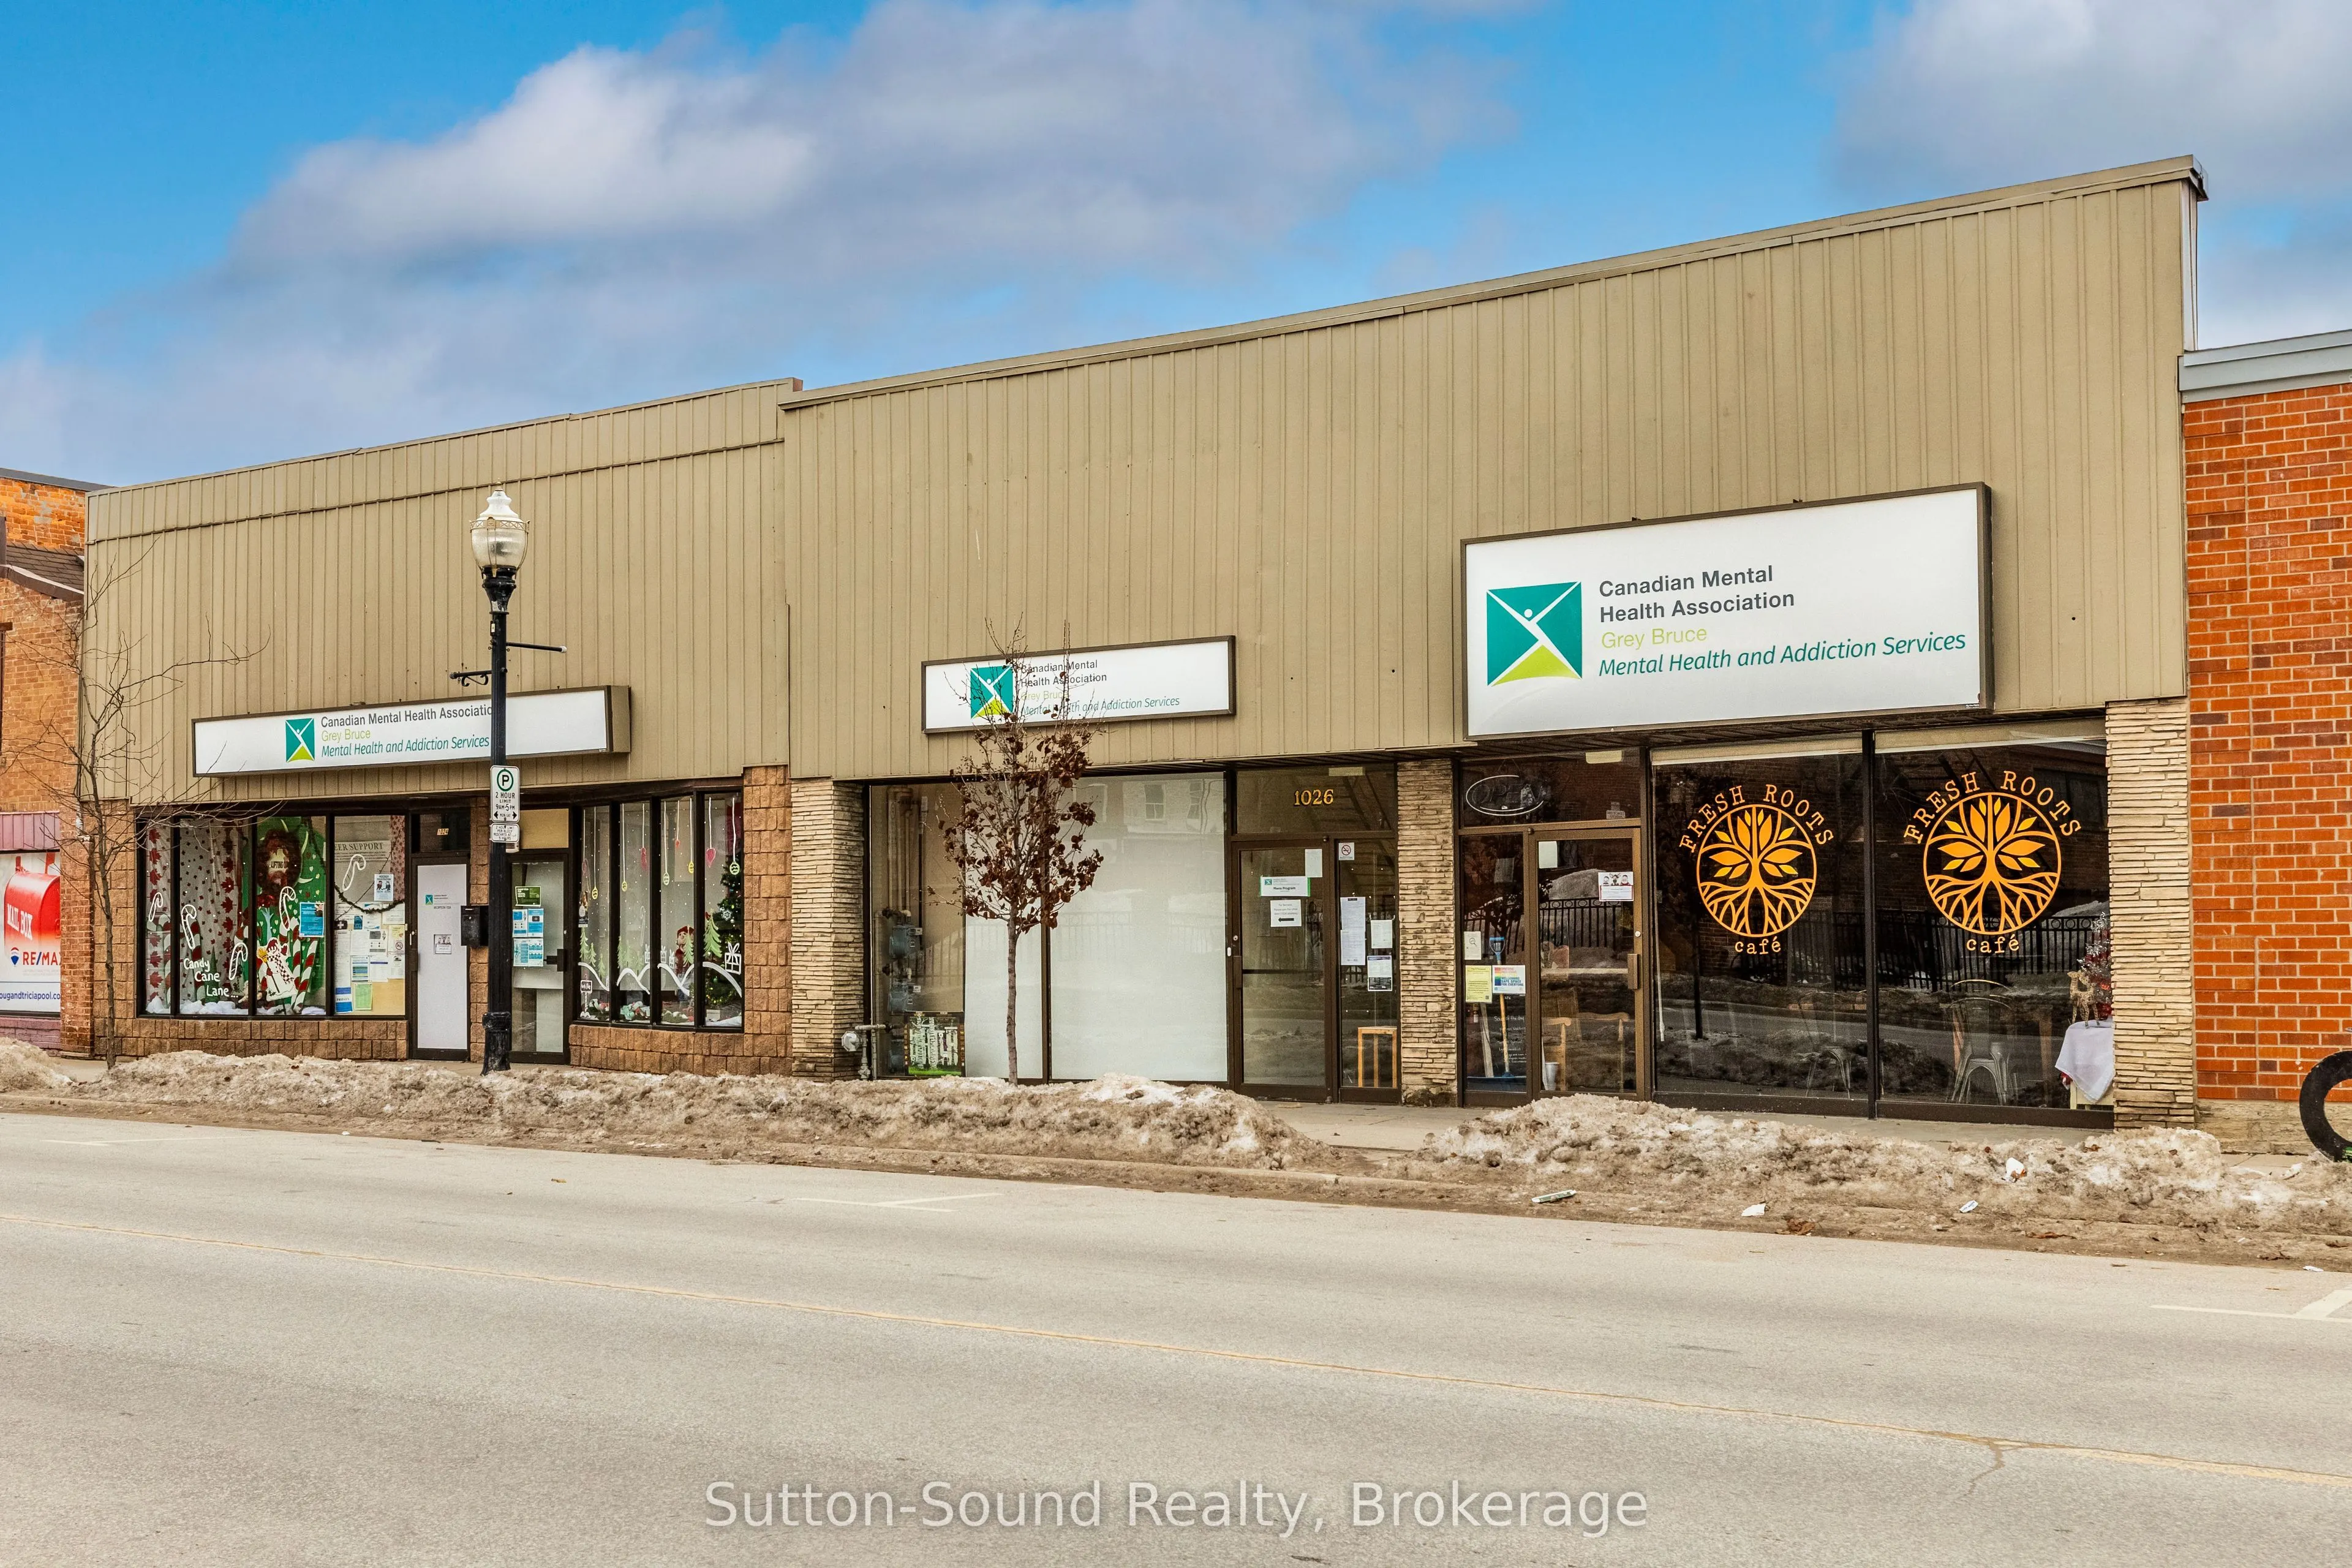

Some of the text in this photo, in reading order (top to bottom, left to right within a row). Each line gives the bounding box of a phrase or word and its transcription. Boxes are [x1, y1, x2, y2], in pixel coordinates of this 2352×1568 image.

[1599, 565, 1773, 597] Canadian Mental
[1600, 591, 1795, 622] Health Association
[1601, 627, 1707, 650] Grey Bruce
[1599, 631, 1966, 677] Mental Health and Addiction Services
[1067, 660, 1098, 671] Mental
[1021, 676, 1050, 687] Health
[1021, 690, 1068, 702] Grey Bruce
[1022, 696, 1180, 715] Mental Hlth and Addiction Services
[321, 704, 492, 728] Canadian Mental Health Associatio
[321, 728, 371, 743] Grey Bruce
[322, 734, 489, 758] Mental Health and Addiction Services
[502, 774, 510, 786] P
[1294, 789, 1334, 805] 1026
[1904, 770, 2081, 844] FRESH ROOTS
[1679, 783, 1834, 853] FRESH ROOTS
[349, 842, 383, 851] SUPPORT
[7, 903, 33, 941] MAIL BOX
[1735, 935, 1781, 955] café
[1966, 933, 2020, 954] café
[23, 951, 61, 966] RE/MA
[184, 957, 211, 973] Candy
[194, 970, 220, 982] Cane
[0, 991, 61, 1001] ougandtriciapool.co
